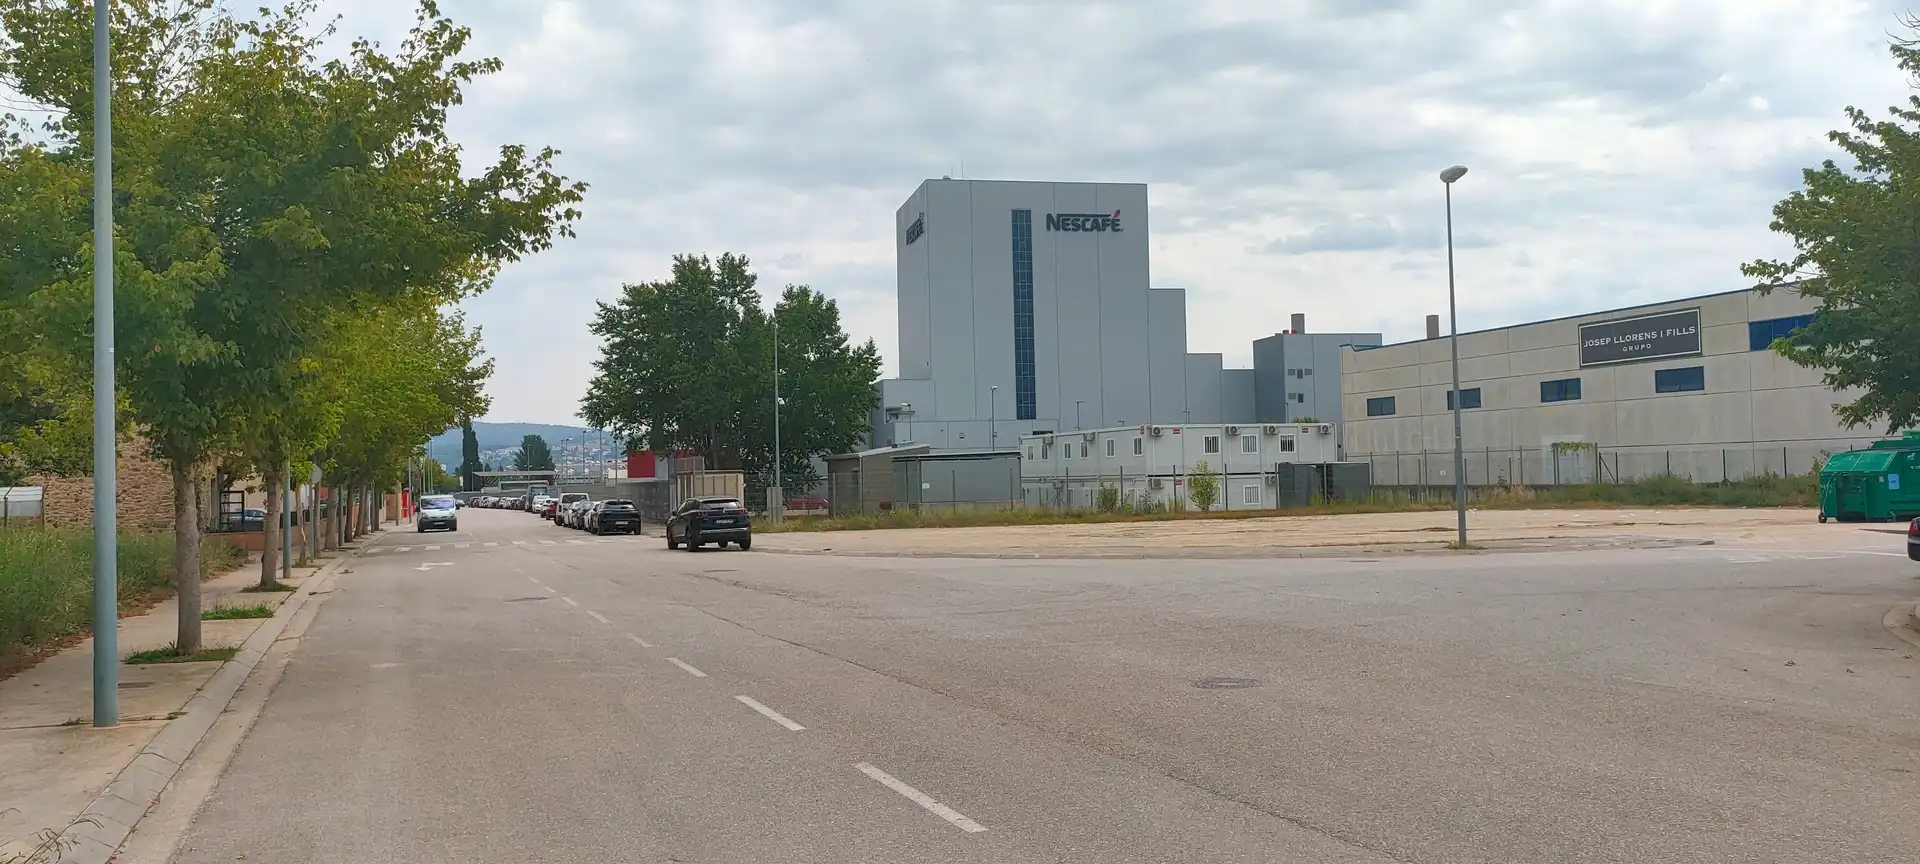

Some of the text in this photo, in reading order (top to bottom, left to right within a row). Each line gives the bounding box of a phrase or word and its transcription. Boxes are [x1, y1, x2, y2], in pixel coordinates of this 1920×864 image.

[1583, 337, 1611, 348] JOSEP
[1613, 331, 1657, 344] LLORENS
[1666, 326, 1696, 337] FILLS
[1622, 343, 1652, 352] GRUPO
